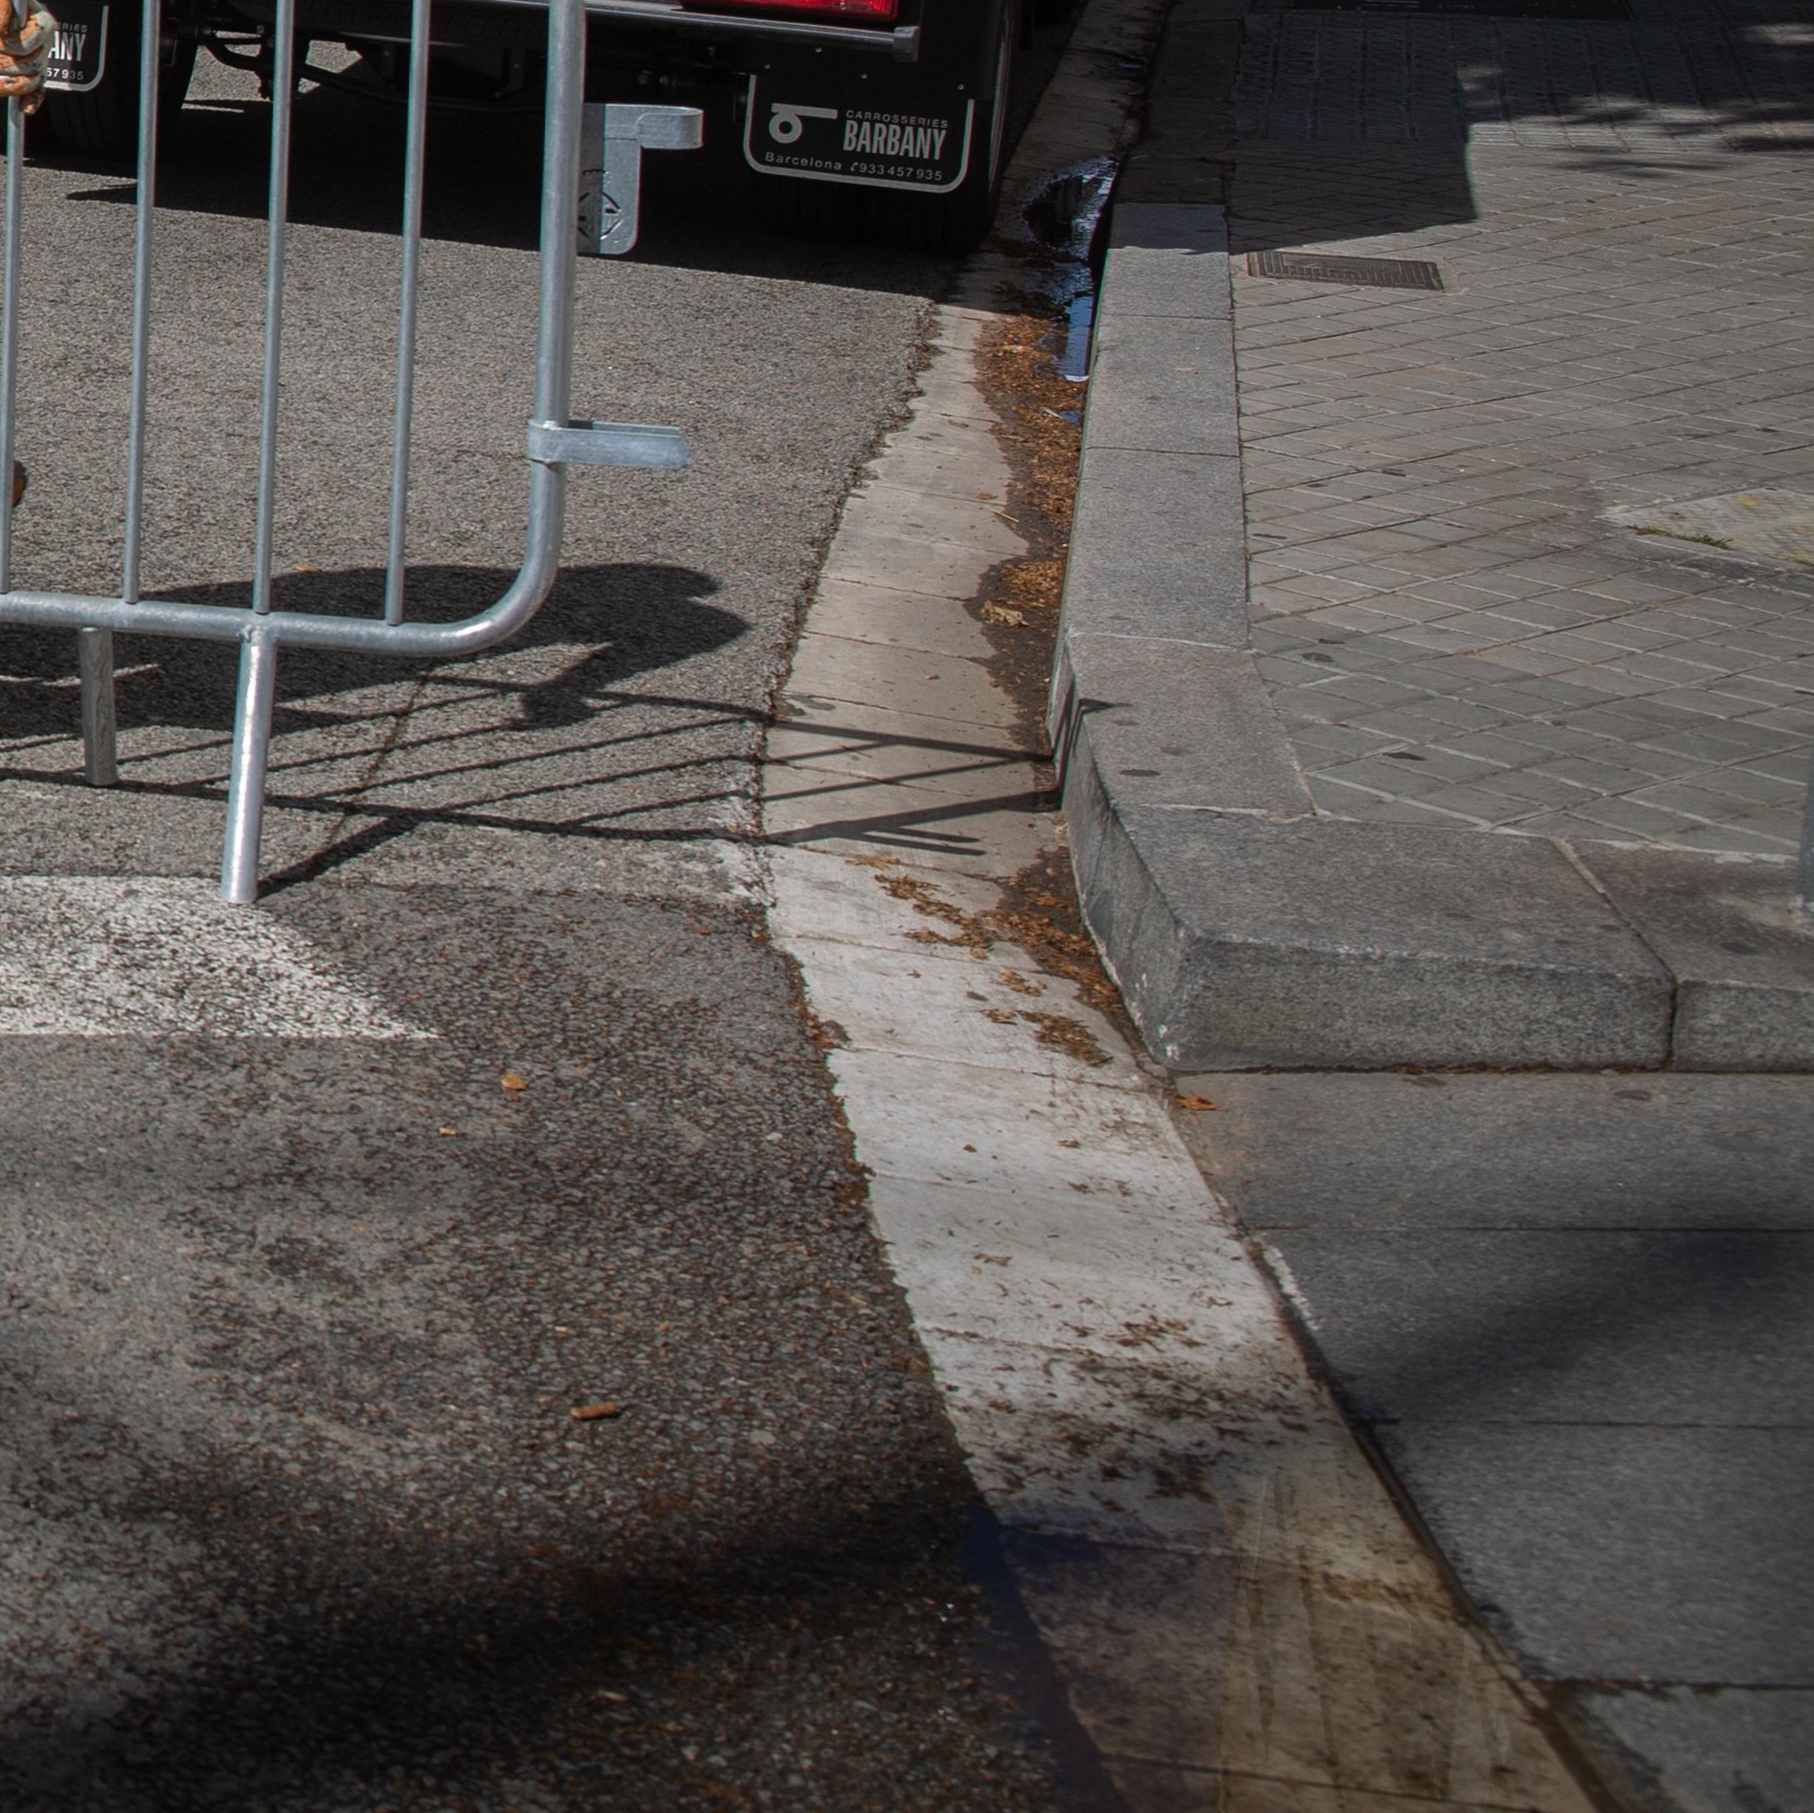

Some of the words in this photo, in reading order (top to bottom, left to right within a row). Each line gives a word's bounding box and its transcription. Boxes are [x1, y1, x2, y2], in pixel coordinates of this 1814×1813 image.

[846, 109, 948, 129] CARROSSERIES
[843, 120, 947, 161] BARBANY
[765, 152, 842, 171] Barcelona
